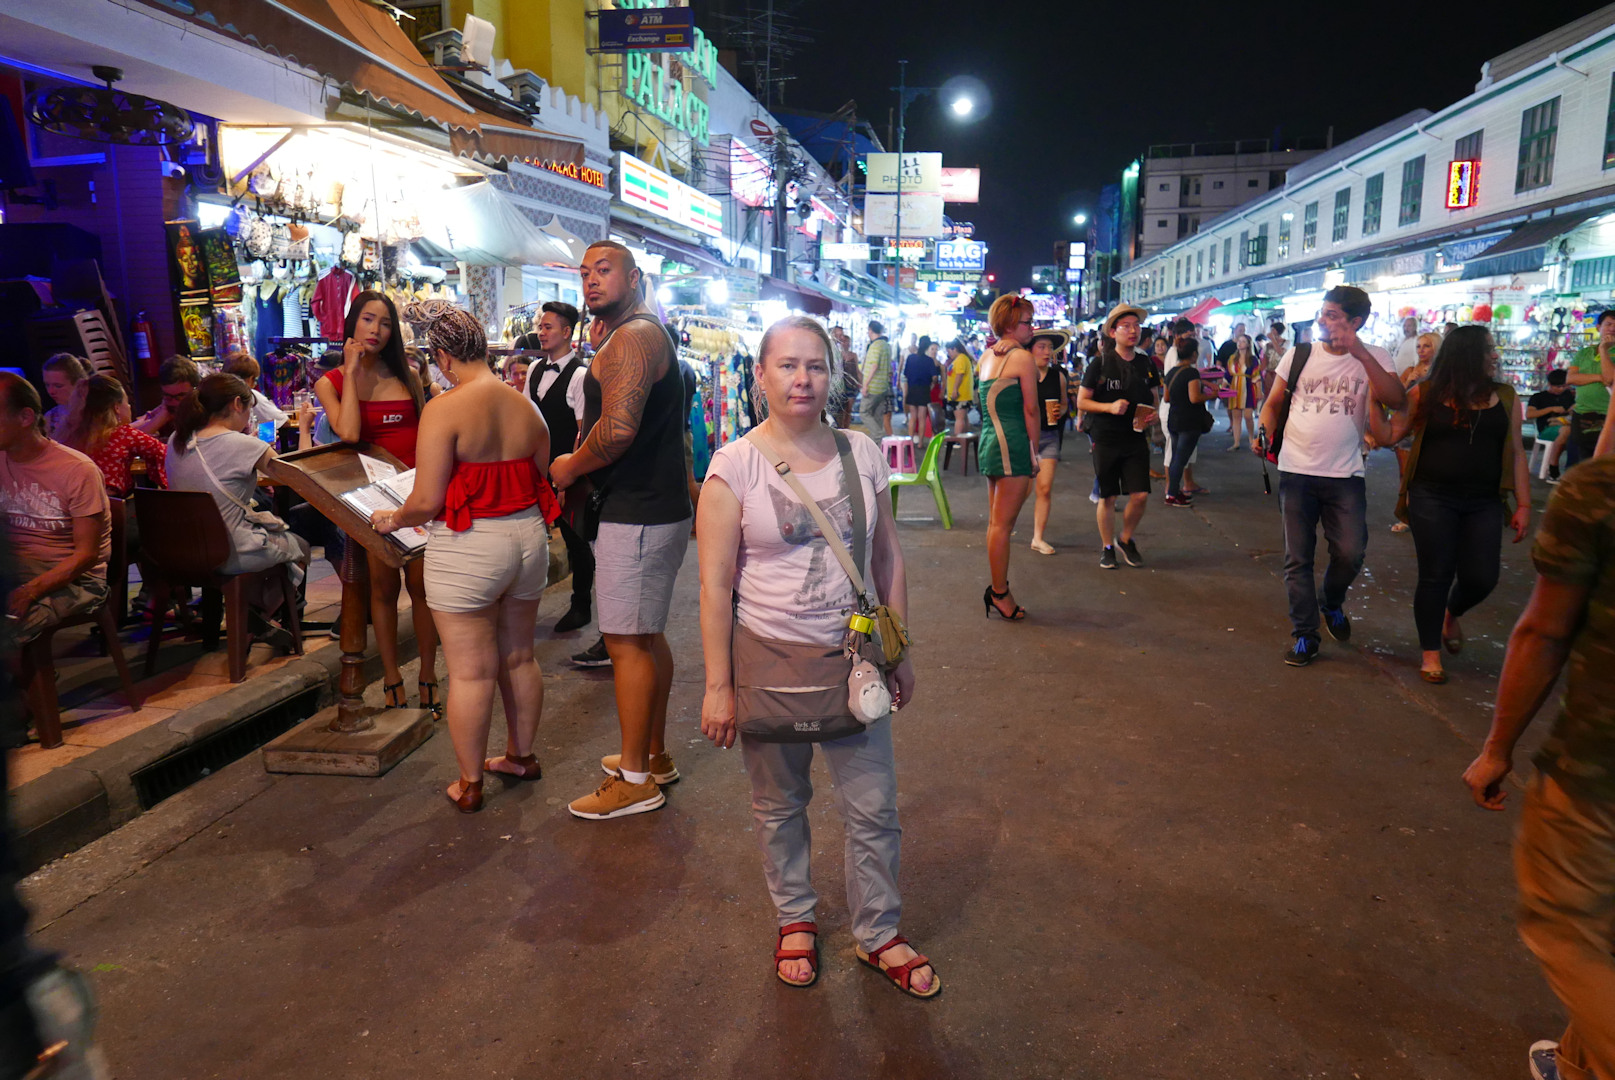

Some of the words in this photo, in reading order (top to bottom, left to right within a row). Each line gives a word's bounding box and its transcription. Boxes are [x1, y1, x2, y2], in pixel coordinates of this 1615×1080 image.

[641, 15, 663, 25] ATM
[627, 35, 660, 43] Exchange
[625, 50, 710, 148] PALACE
[547, 161, 579, 179] ALACE
[581, 166, 605, 188] HOTEL
[882, 175, 923, 184] PHOTO
[939, 244, 981, 259] BAG
[1302, 375, 1365, 395] WHAT
[1301, 395, 1357, 416] EVER
[383, 414, 403, 424] LEO
